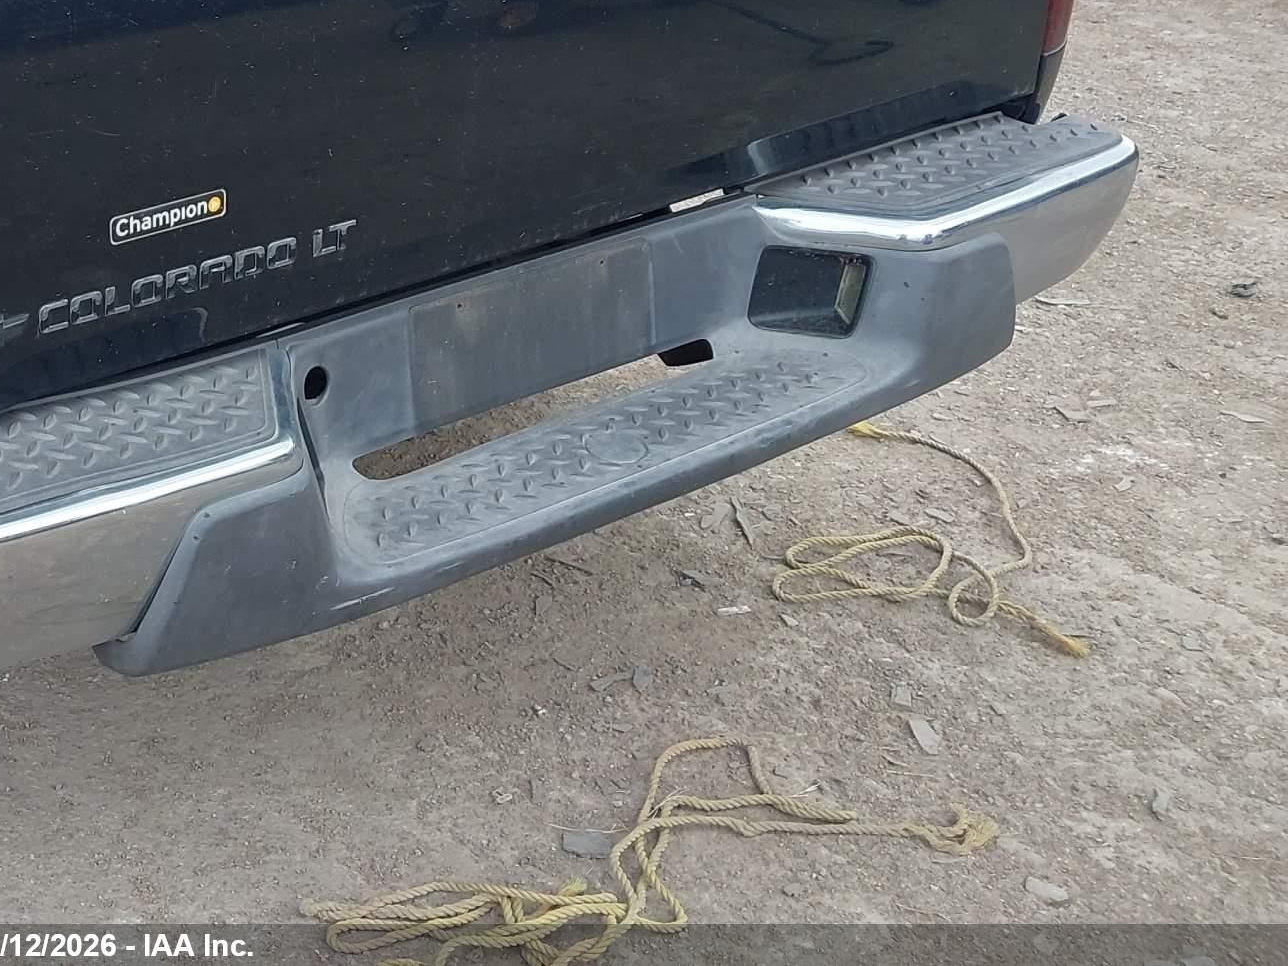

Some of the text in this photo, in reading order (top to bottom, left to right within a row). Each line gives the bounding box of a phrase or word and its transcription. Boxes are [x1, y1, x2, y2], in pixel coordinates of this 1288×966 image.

[115, 199, 208, 238] Champion
[39, 219, 357, 334] COLORADO LT
